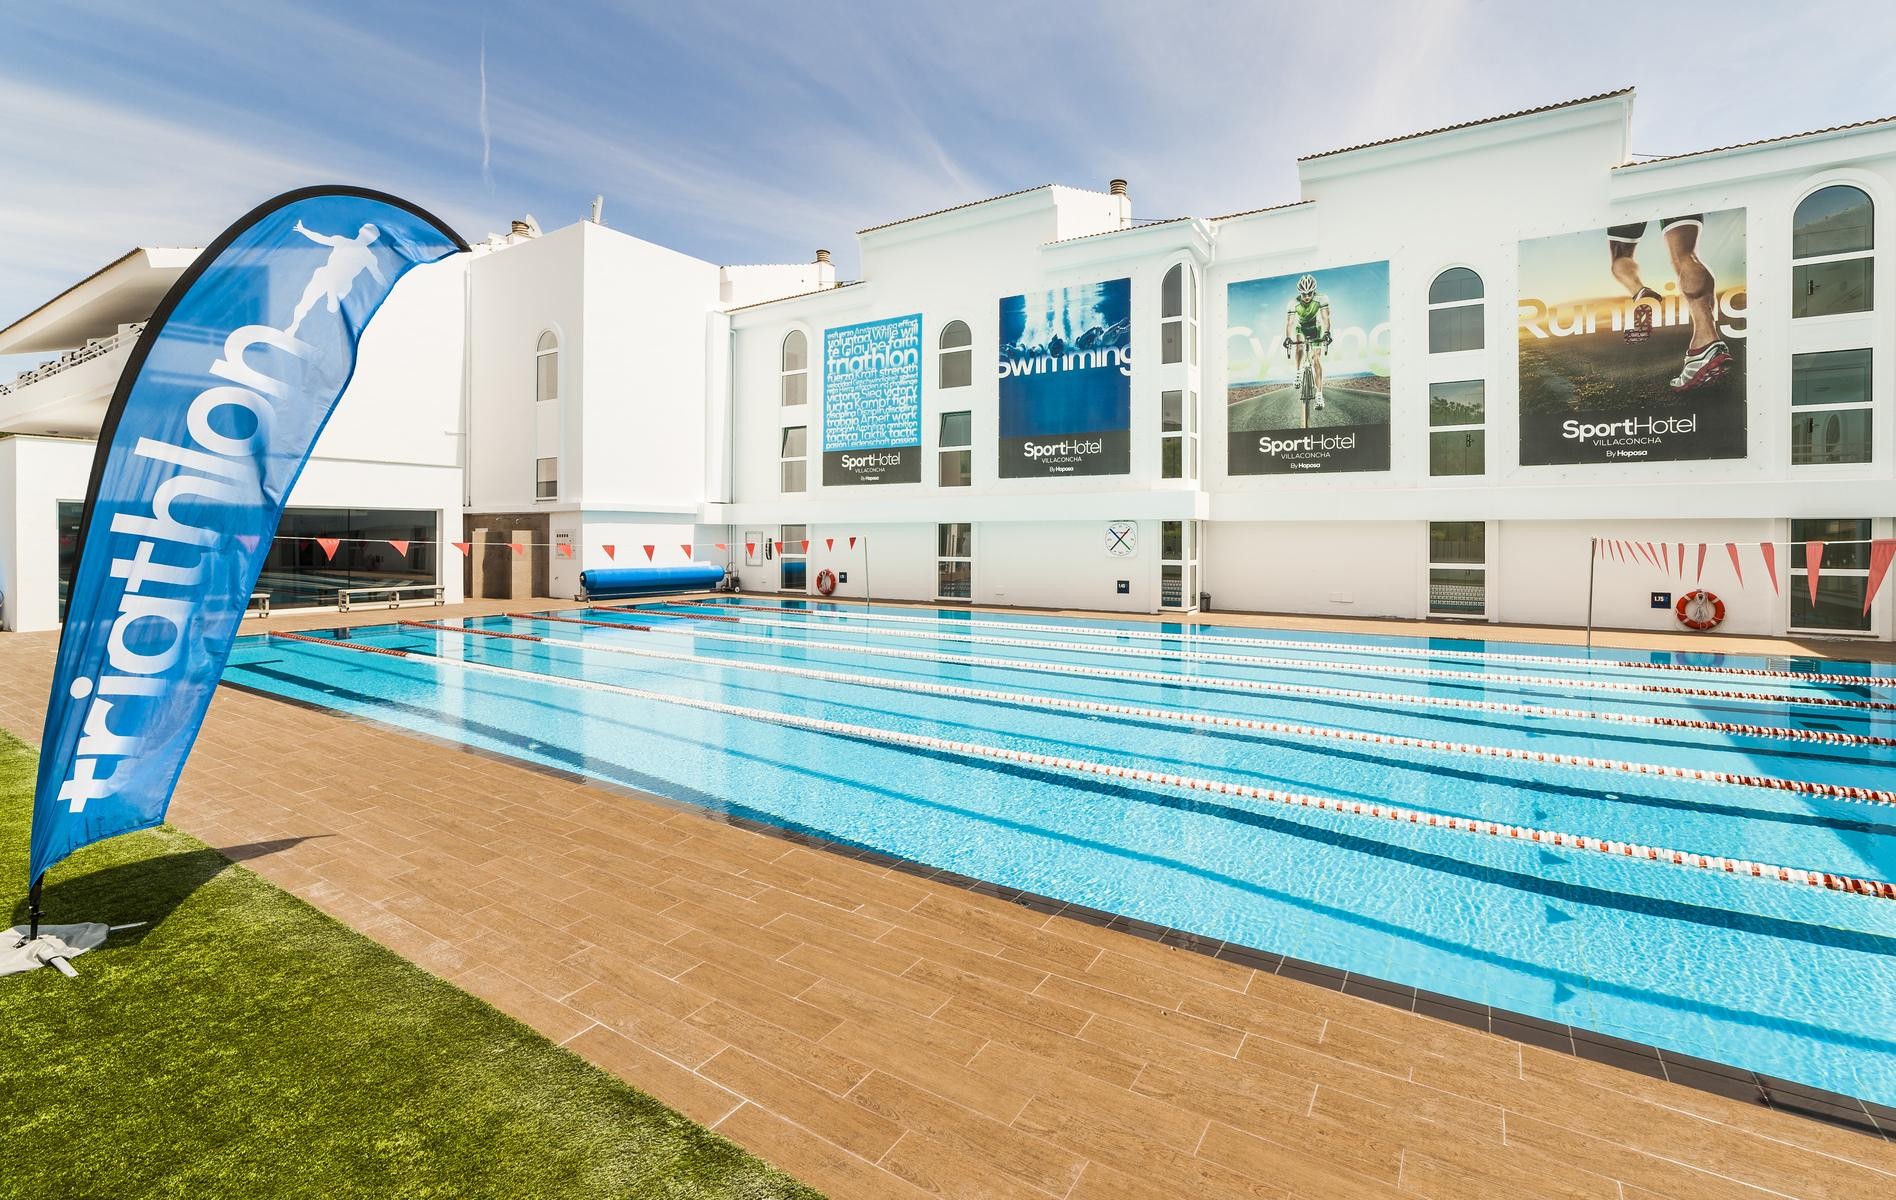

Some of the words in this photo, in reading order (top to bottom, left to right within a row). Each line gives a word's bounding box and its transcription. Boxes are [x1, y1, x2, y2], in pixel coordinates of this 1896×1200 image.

[828, 334, 870, 346] voluntad
[871, 325, 898, 340] Wille
[900, 323, 918, 338] will
[828, 346, 839, 358] fe
[842, 340, 886, 356] Glaube
[888, 335, 918, 350] faith
[1227, 322, 1391, 379] Cyng
[828, 345, 918, 374] triathlon
[828, 373, 854, 382] fuerza
[856, 368, 877, 378] Kraft
[880, 364, 918, 376] strength
[827, 400, 852, 412] lucha
[855, 396, 890, 411] Kampf
[893, 394, 917, 407] fight
[828, 391, 860, 402] victoria
[862, 388, 882, 398] Sieg
[884, 385, 917, 398] victory
[827, 416, 858, 428] trabajo
[861, 413, 890, 424] Arbeit
[892, 410, 917, 420] work
[1562, 413, 1697, 442] SportHotel
[861, 428, 886, 440] Taktik
[889, 426, 917, 438] tactic
[1592, 436, 1662, 446] VILLACONCHA
[1023, 438, 1102, 460] SportHotel
[1259, 433, 1356, 456] SportHotel
[1606, 449, 1616, 458] By
[1617, 449, 1648, 457] Hoposa
[841, 451, 900, 470] SportHotel
[57, 324, 320, 813] triathlon
